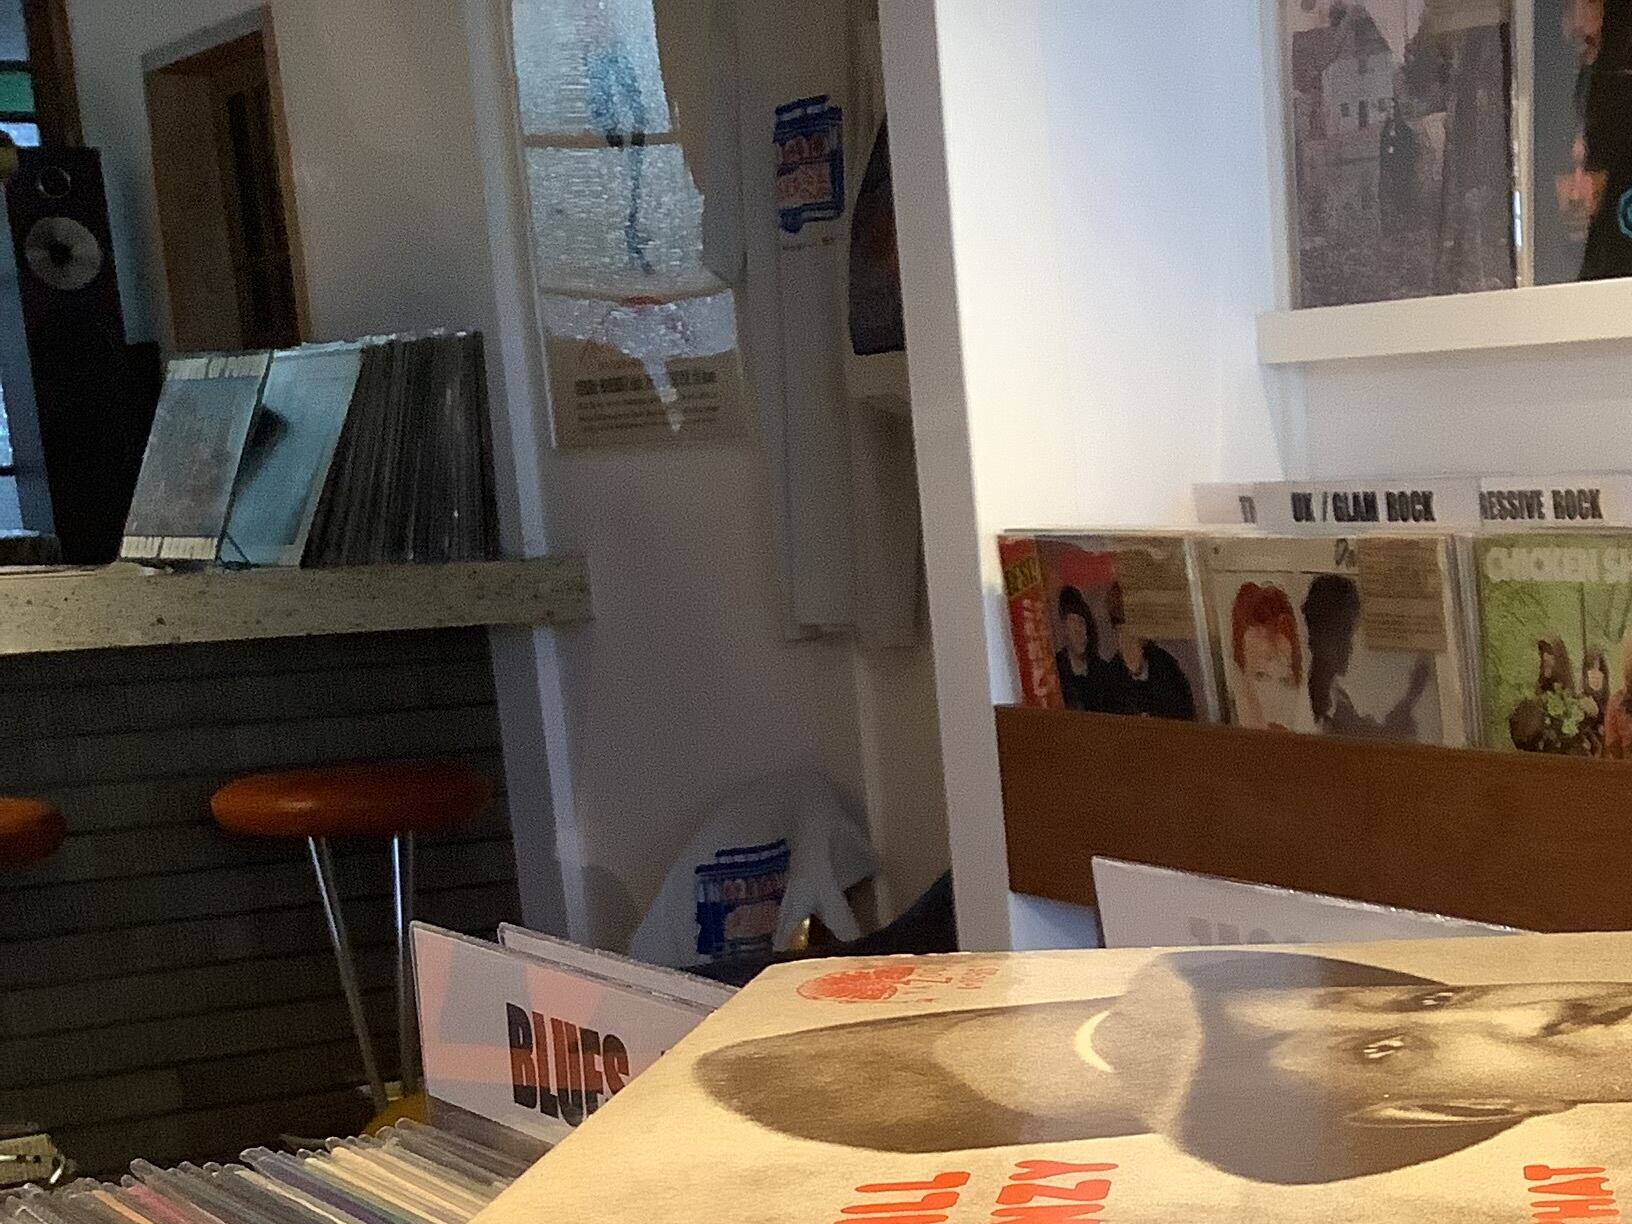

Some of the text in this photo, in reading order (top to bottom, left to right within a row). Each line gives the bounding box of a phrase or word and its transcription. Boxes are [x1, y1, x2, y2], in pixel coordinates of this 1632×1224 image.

[1290, 491, 1316, 523] UK
[1332, 491, 1380, 523] GLAM
[1384, 489, 1438, 523] ROCK
[1550, 487, 1604, 521] ROCK
[1487, 547, 1598, 583] CHICKEN
[506, 1002, 630, 1128] BLUES
